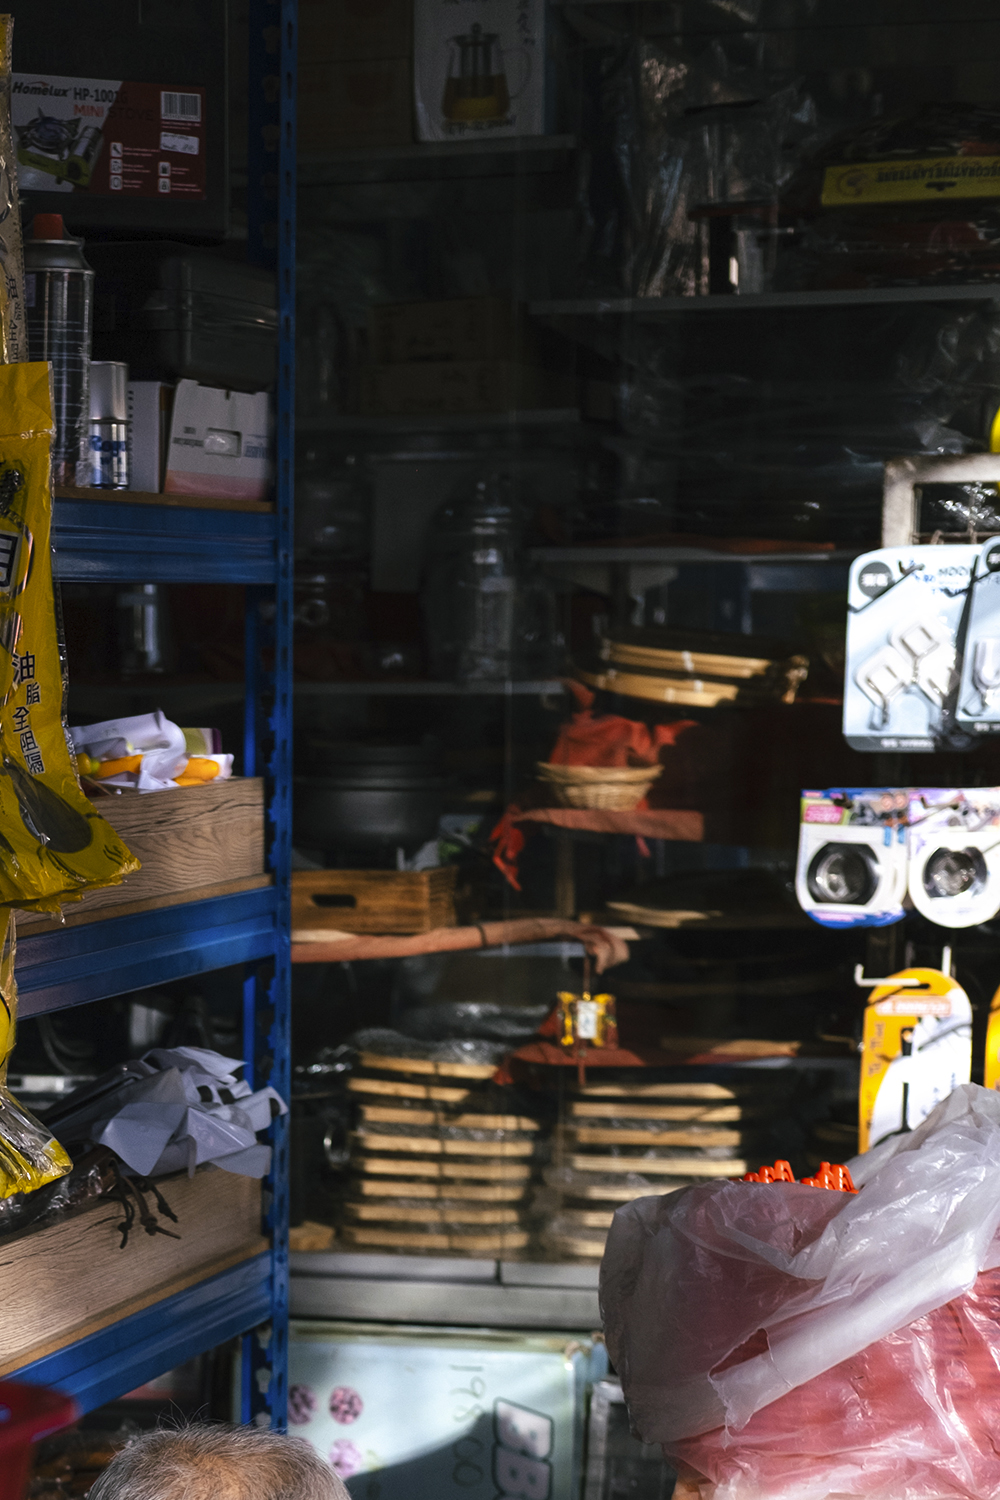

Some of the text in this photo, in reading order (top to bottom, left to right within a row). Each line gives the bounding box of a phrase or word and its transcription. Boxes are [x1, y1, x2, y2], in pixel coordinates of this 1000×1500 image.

[12, 81, 68, 97] Homelux
[73, 104, 154, 120] MINI STOVE
